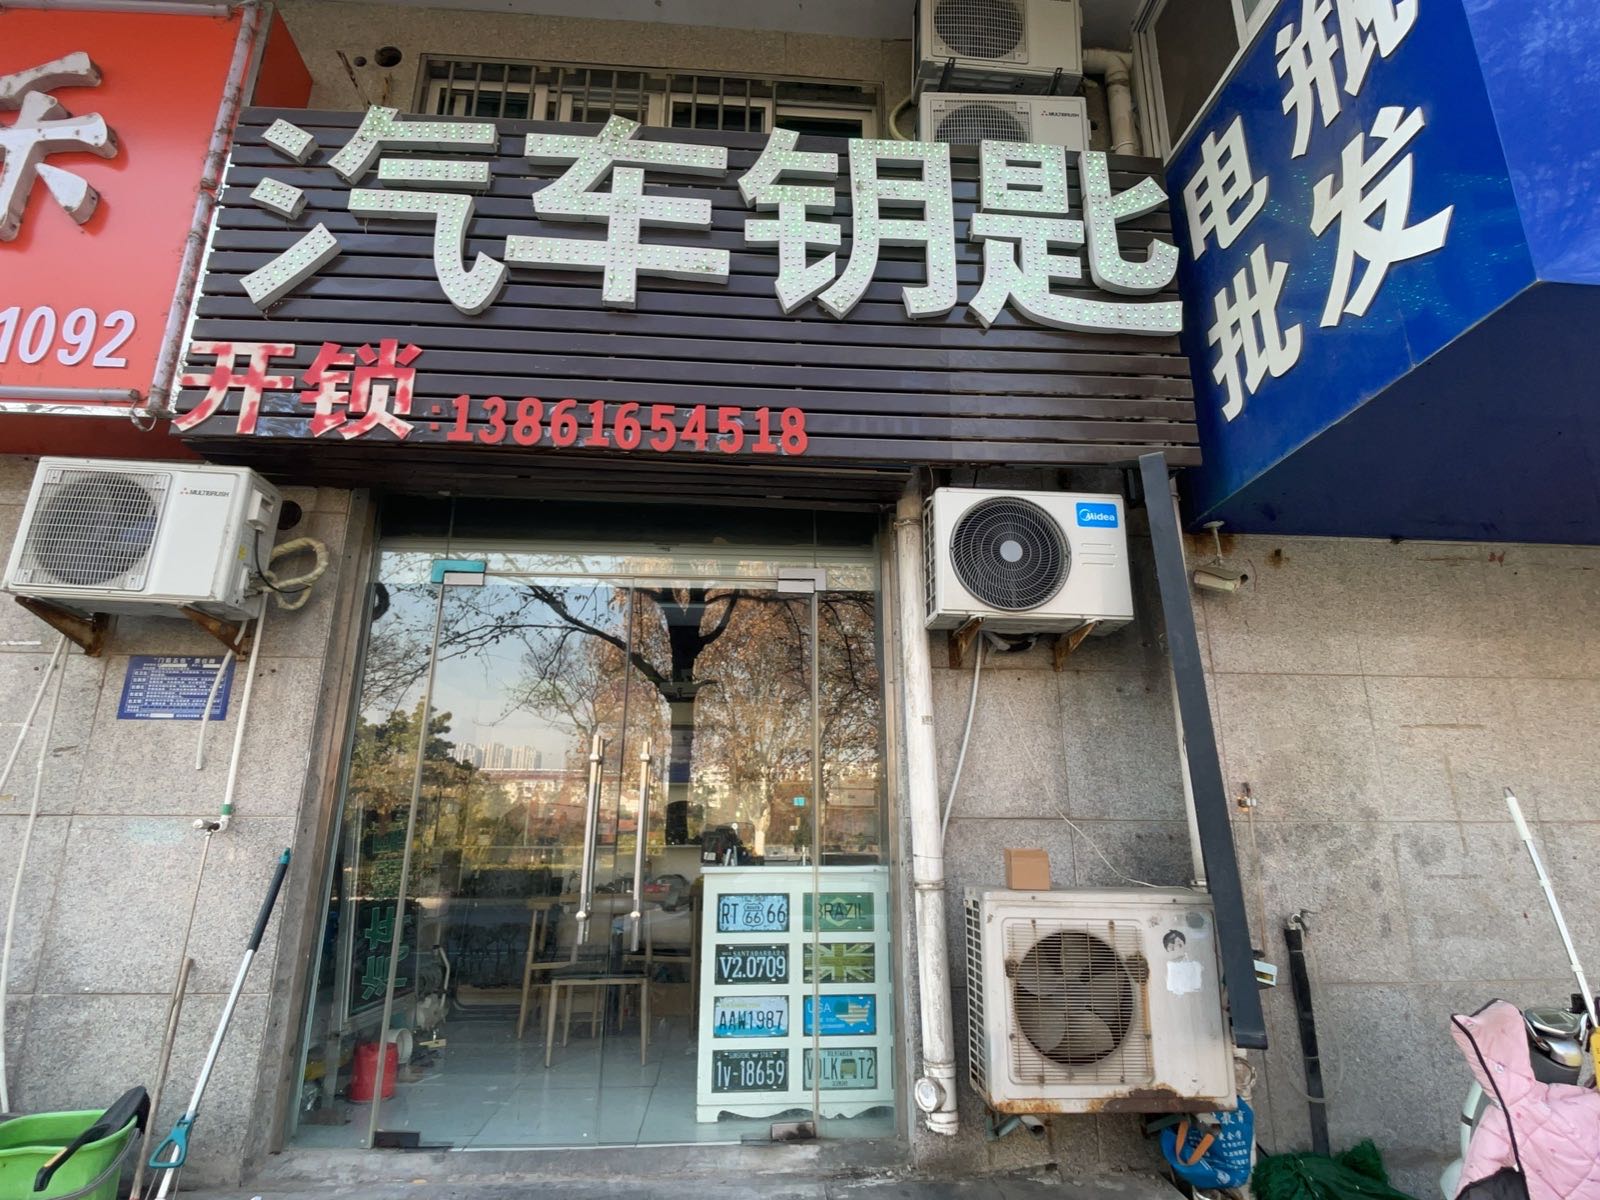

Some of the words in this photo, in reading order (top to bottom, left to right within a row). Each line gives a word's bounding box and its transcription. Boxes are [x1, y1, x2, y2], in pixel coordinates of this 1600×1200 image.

[239, 104, 1184, 337] 汽车钥匙
[1208, 106, 1453, 421] 批发
[0, 305, 137, 368] 1092
[172, 340, 422, 438] 开锁
[1081, 510, 1115, 521] Midea
[721, 903, 739, 924] RT
[766, 903, 786, 924] 66
[745, 912, 761, 924] 66
[719, 956, 786, 978] V2.0709
[718, 1010, 784, 1030] AAW1987
[858, 1057, 874, 1080] T2
